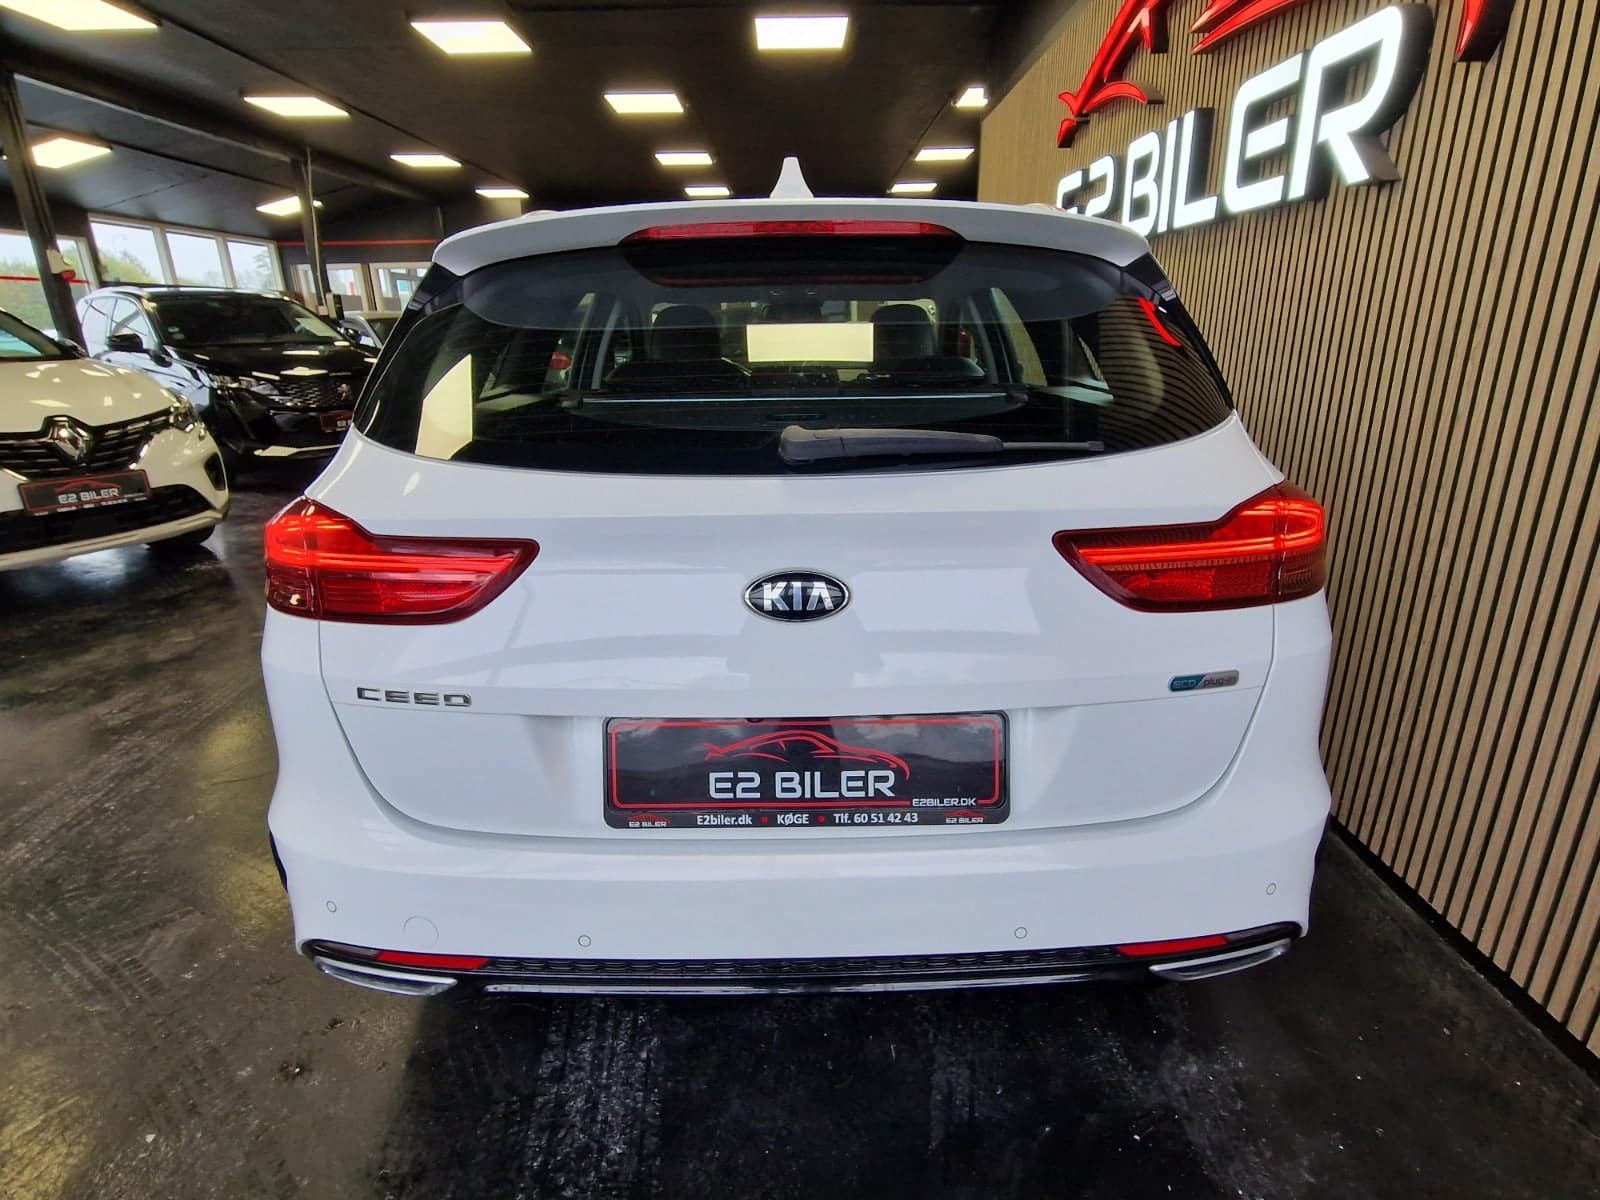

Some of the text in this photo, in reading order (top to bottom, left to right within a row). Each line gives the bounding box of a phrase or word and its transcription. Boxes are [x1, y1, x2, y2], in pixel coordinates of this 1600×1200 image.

[1121, 5, 1404, 238] BILER
[58, 493, 79, 504] E2
[80, 488, 120, 502] BILER
[762, 581, 835, 611] KIA
[356, 686, 472, 708] CEED
[709, 769, 896, 799] E2 BILER
[912, 797, 977, 808] E2BILER.DK
[696, 812, 919, 826] E2biler.dk KØGE Tlf. 60 51 42 43
